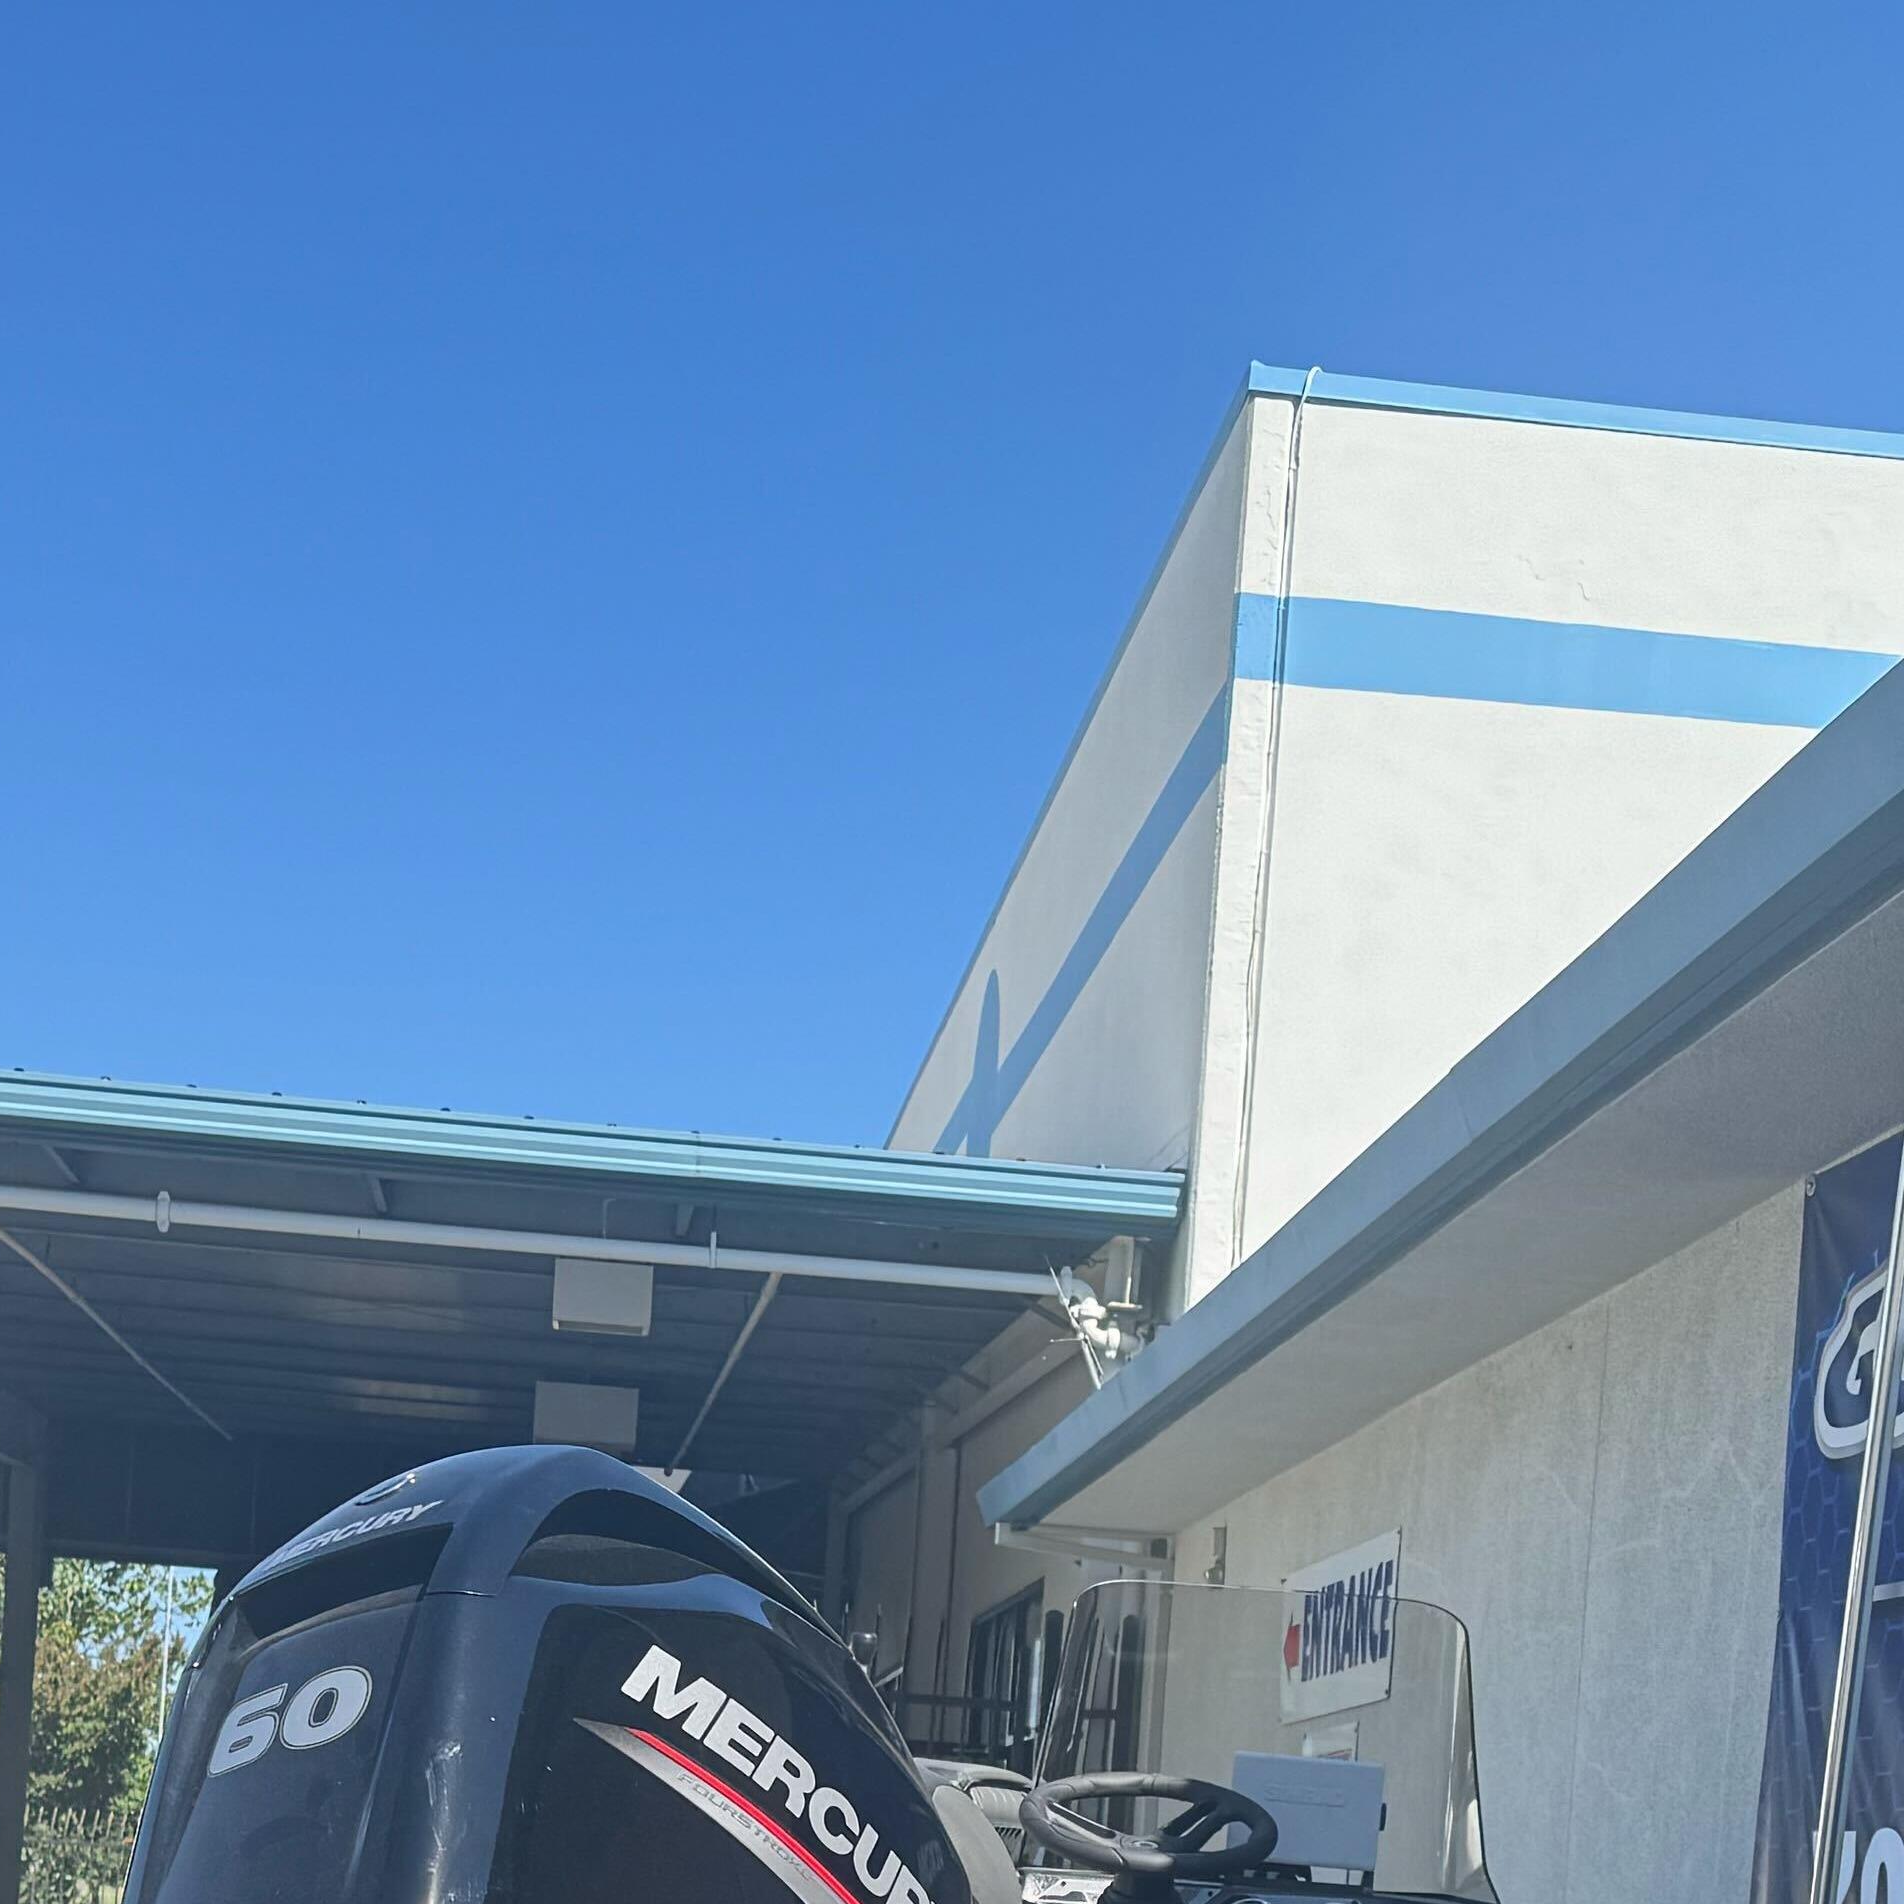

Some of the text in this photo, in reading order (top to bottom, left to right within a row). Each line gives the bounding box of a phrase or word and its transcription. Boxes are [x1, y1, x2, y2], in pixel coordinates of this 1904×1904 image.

[1301, 1560, 1393, 1682] ENTRANCE
[205, 1666, 373, 1777] 60
[675, 1773, 815, 1882] FOURSTROKE
